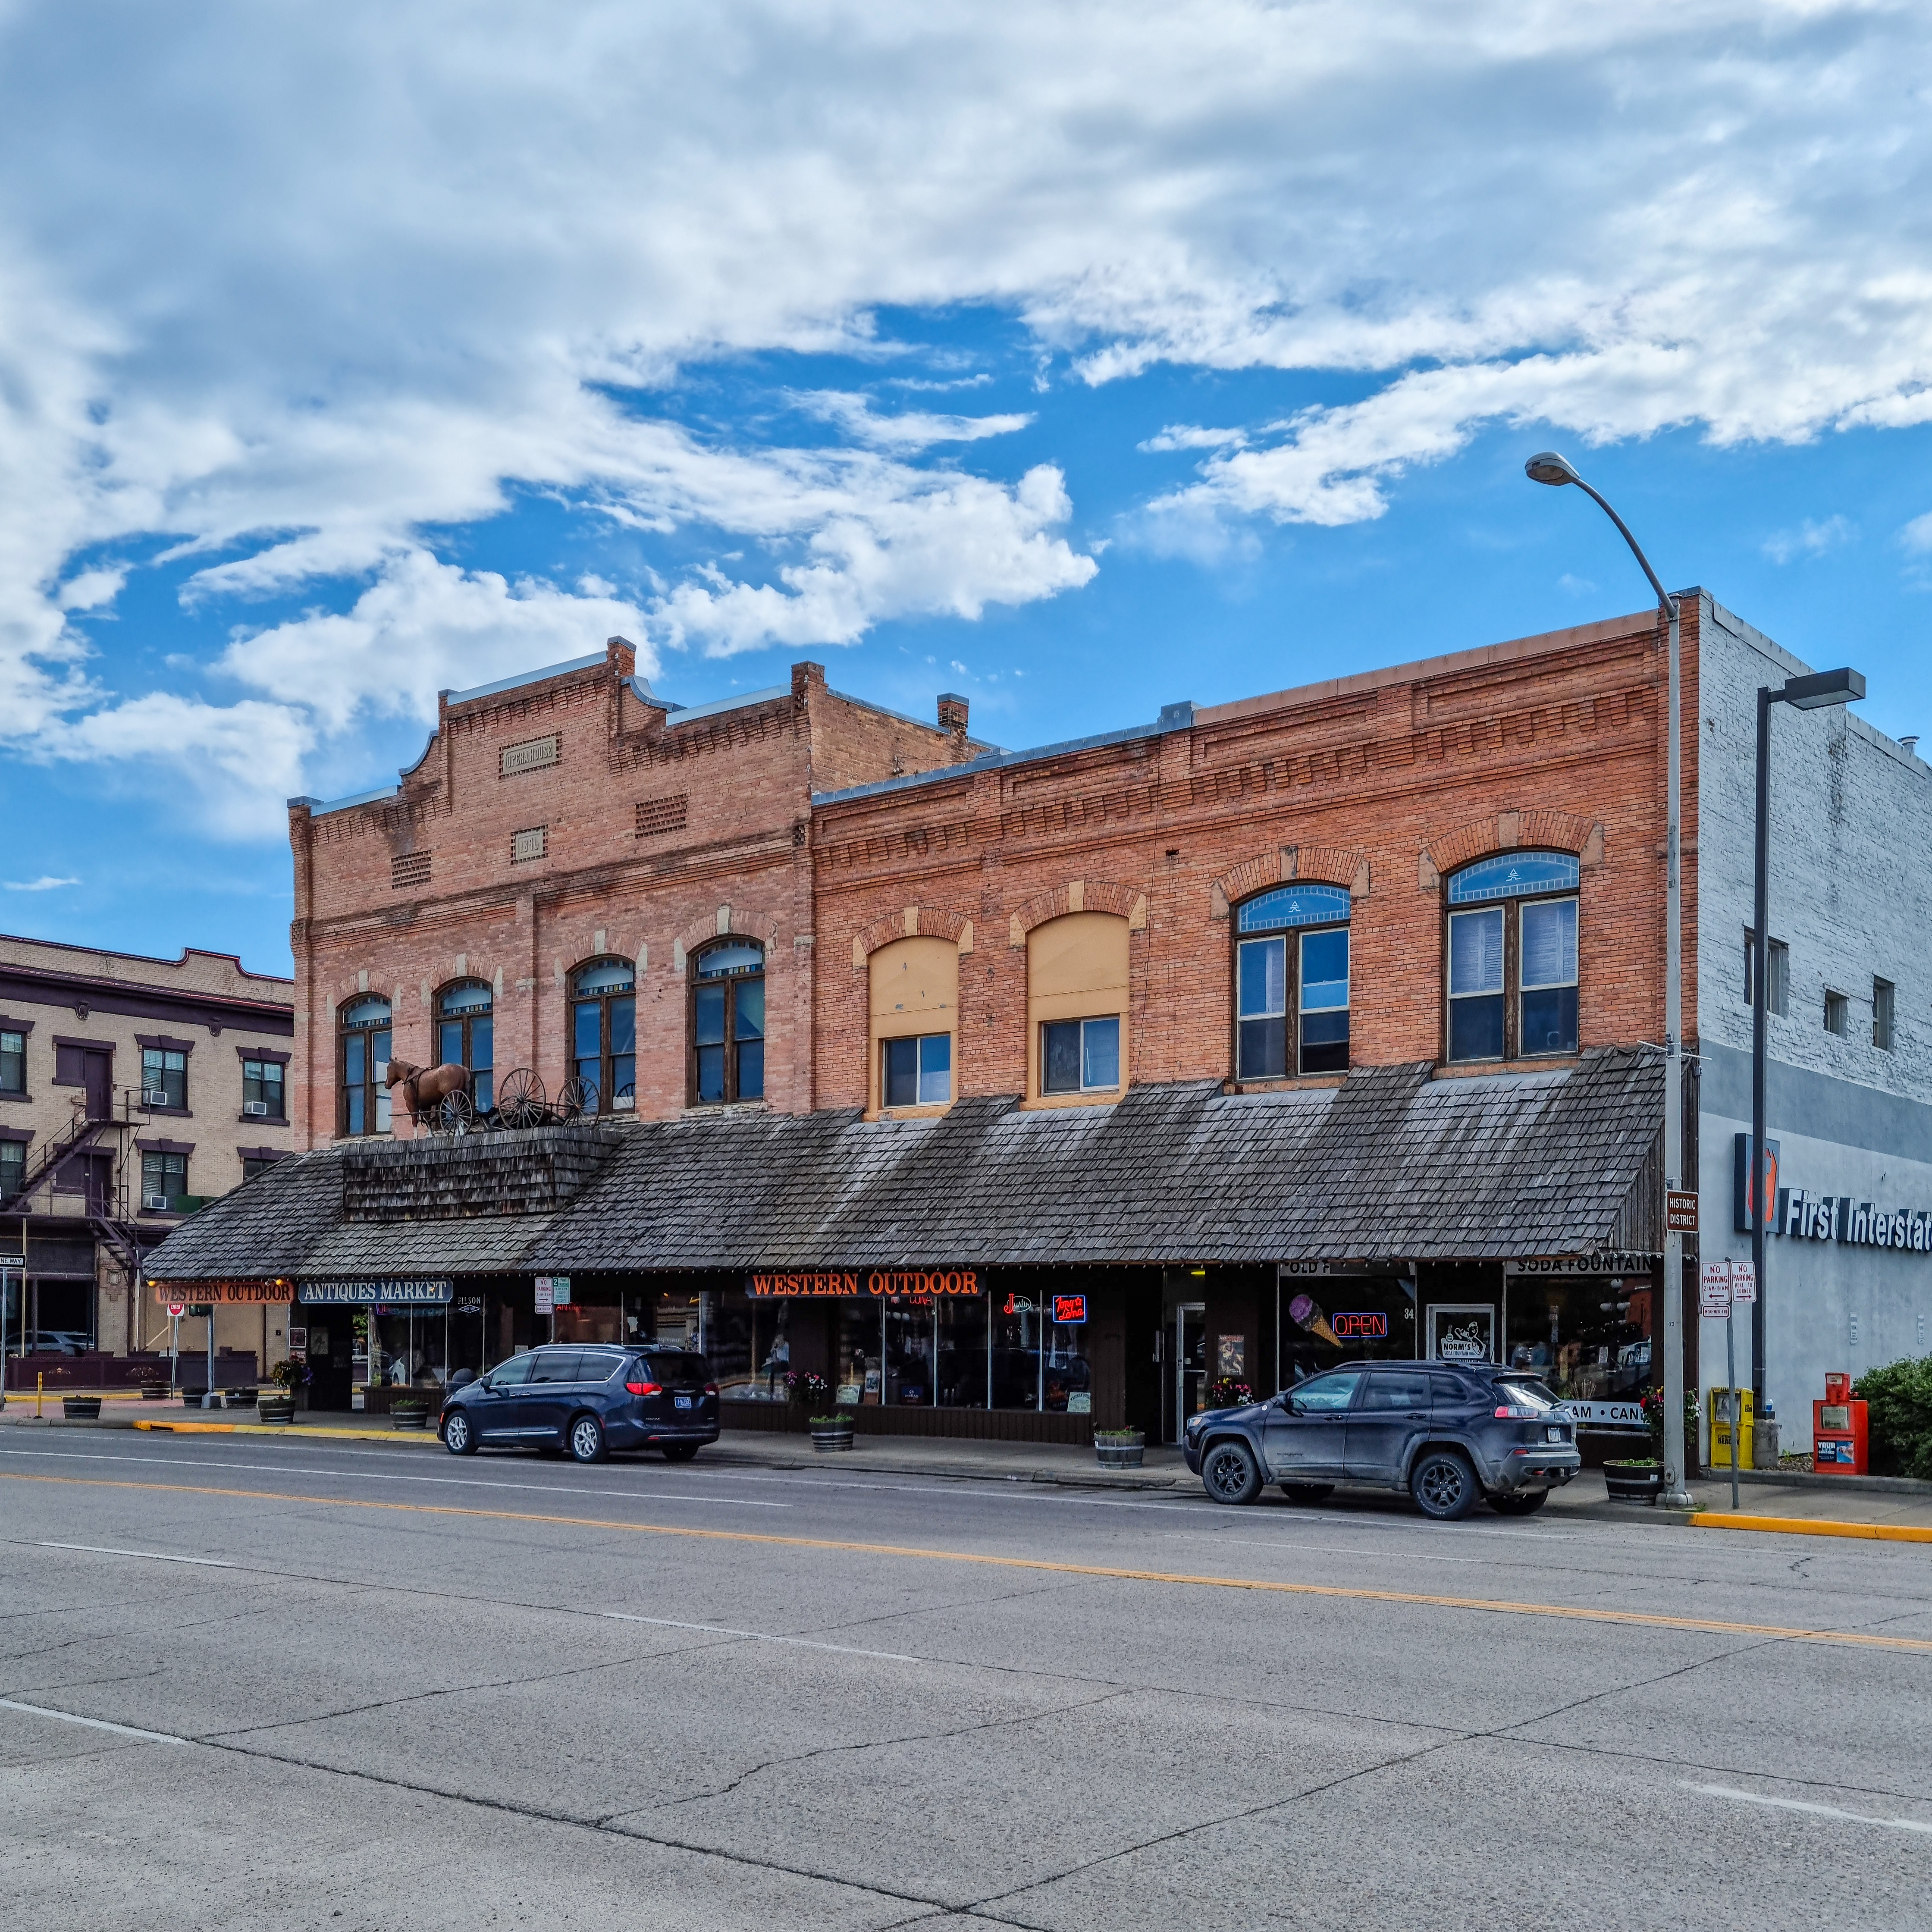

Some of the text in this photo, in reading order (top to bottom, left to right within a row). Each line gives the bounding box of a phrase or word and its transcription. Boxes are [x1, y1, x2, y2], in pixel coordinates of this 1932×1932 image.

[506, 743, 552, 768] OPERA HOUSE
[1670, 1197, 1695, 1210] HISTORIC
[1670, 1214, 1695, 1226] DISTRICT
[1786, 1188, 1932, 1250] First Interstat
[1518, 1256, 1651, 1272] SODA FOUNTAIN
[159, 1285, 290, 1302] WESTERN OUTDOOR
[304, 1281, 447, 1302] ANTIQUES MARKET
[753, 1272, 978, 1295] WESTERN OUTDOOR
[1335, 1315, 1384, 1335] OPEN
